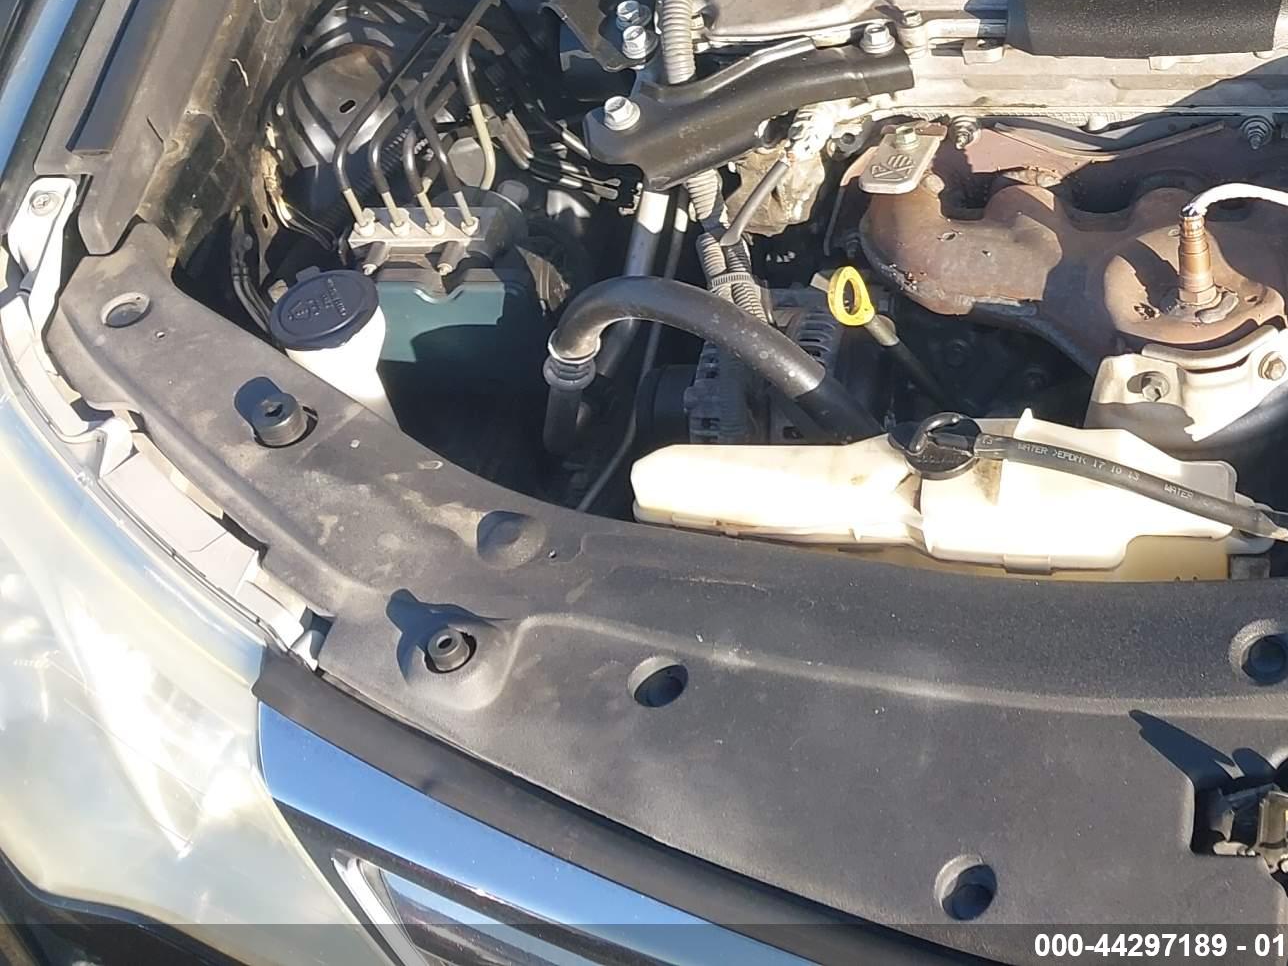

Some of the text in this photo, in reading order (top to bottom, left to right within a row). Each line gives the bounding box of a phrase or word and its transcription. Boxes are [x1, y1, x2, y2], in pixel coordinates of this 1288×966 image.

[1017, 441, 1049, 456] WATER
[1092, 459, 1106, 470] 17
[1109, 465, 1122, 476] 10
[1163, 483, 1194, 500] WATER
